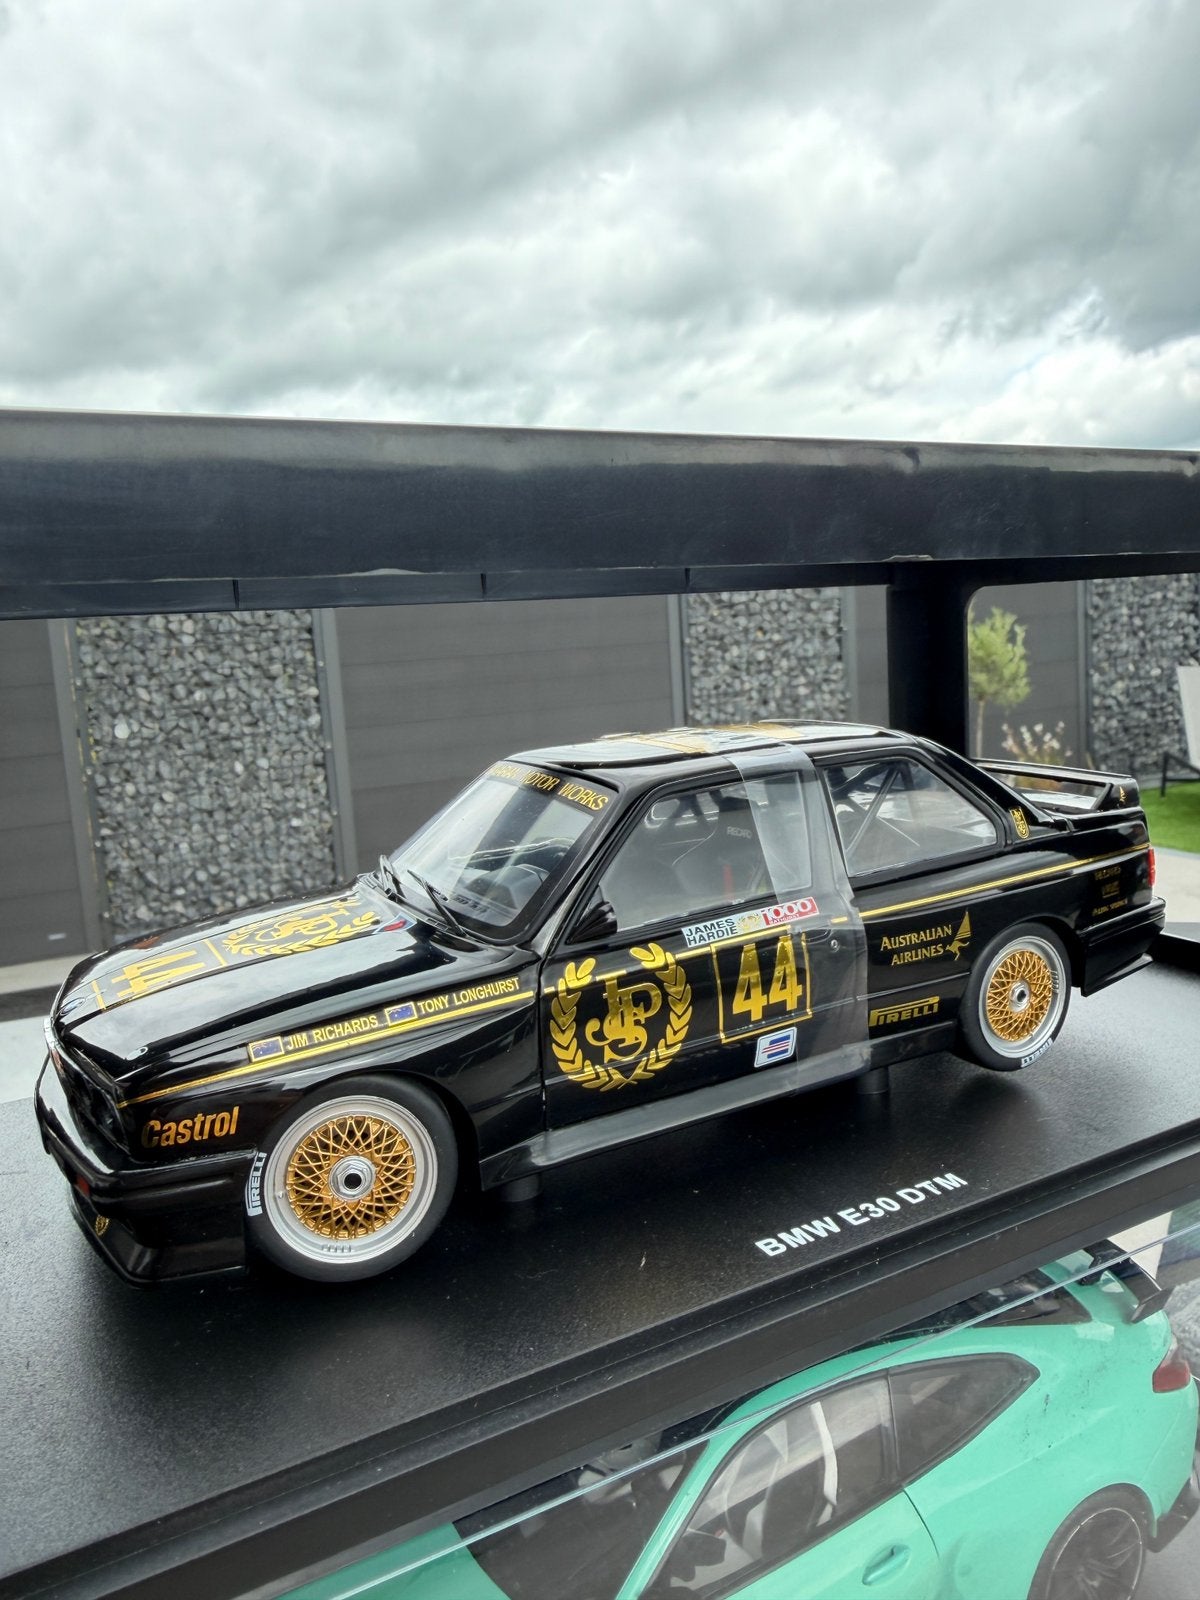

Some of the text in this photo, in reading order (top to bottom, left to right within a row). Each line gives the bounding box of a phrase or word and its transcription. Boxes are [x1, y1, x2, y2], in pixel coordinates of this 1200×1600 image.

[557, 782, 609, 811] WORKS
[762, 897, 813, 924] 1000
[685, 918, 735, 937] JAMES
[686, 926, 738, 946] HARDIE
[880, 924, 952, 951] AUSTRALIAN
[891, 943, 944, 967] AIRLINES
[732, 934, 803, 1021] 44
[286, 977, 520, 1051] JIM RICHARDS TONY LONGHURST
[868, 995, 940, 1028] PIRELLI
[141, 1106, 240, 1149] Castrol
[244, 1151, 268, 1217] PIRELLI
[754, 1172, 969, 1257] BMW E30 DTM
